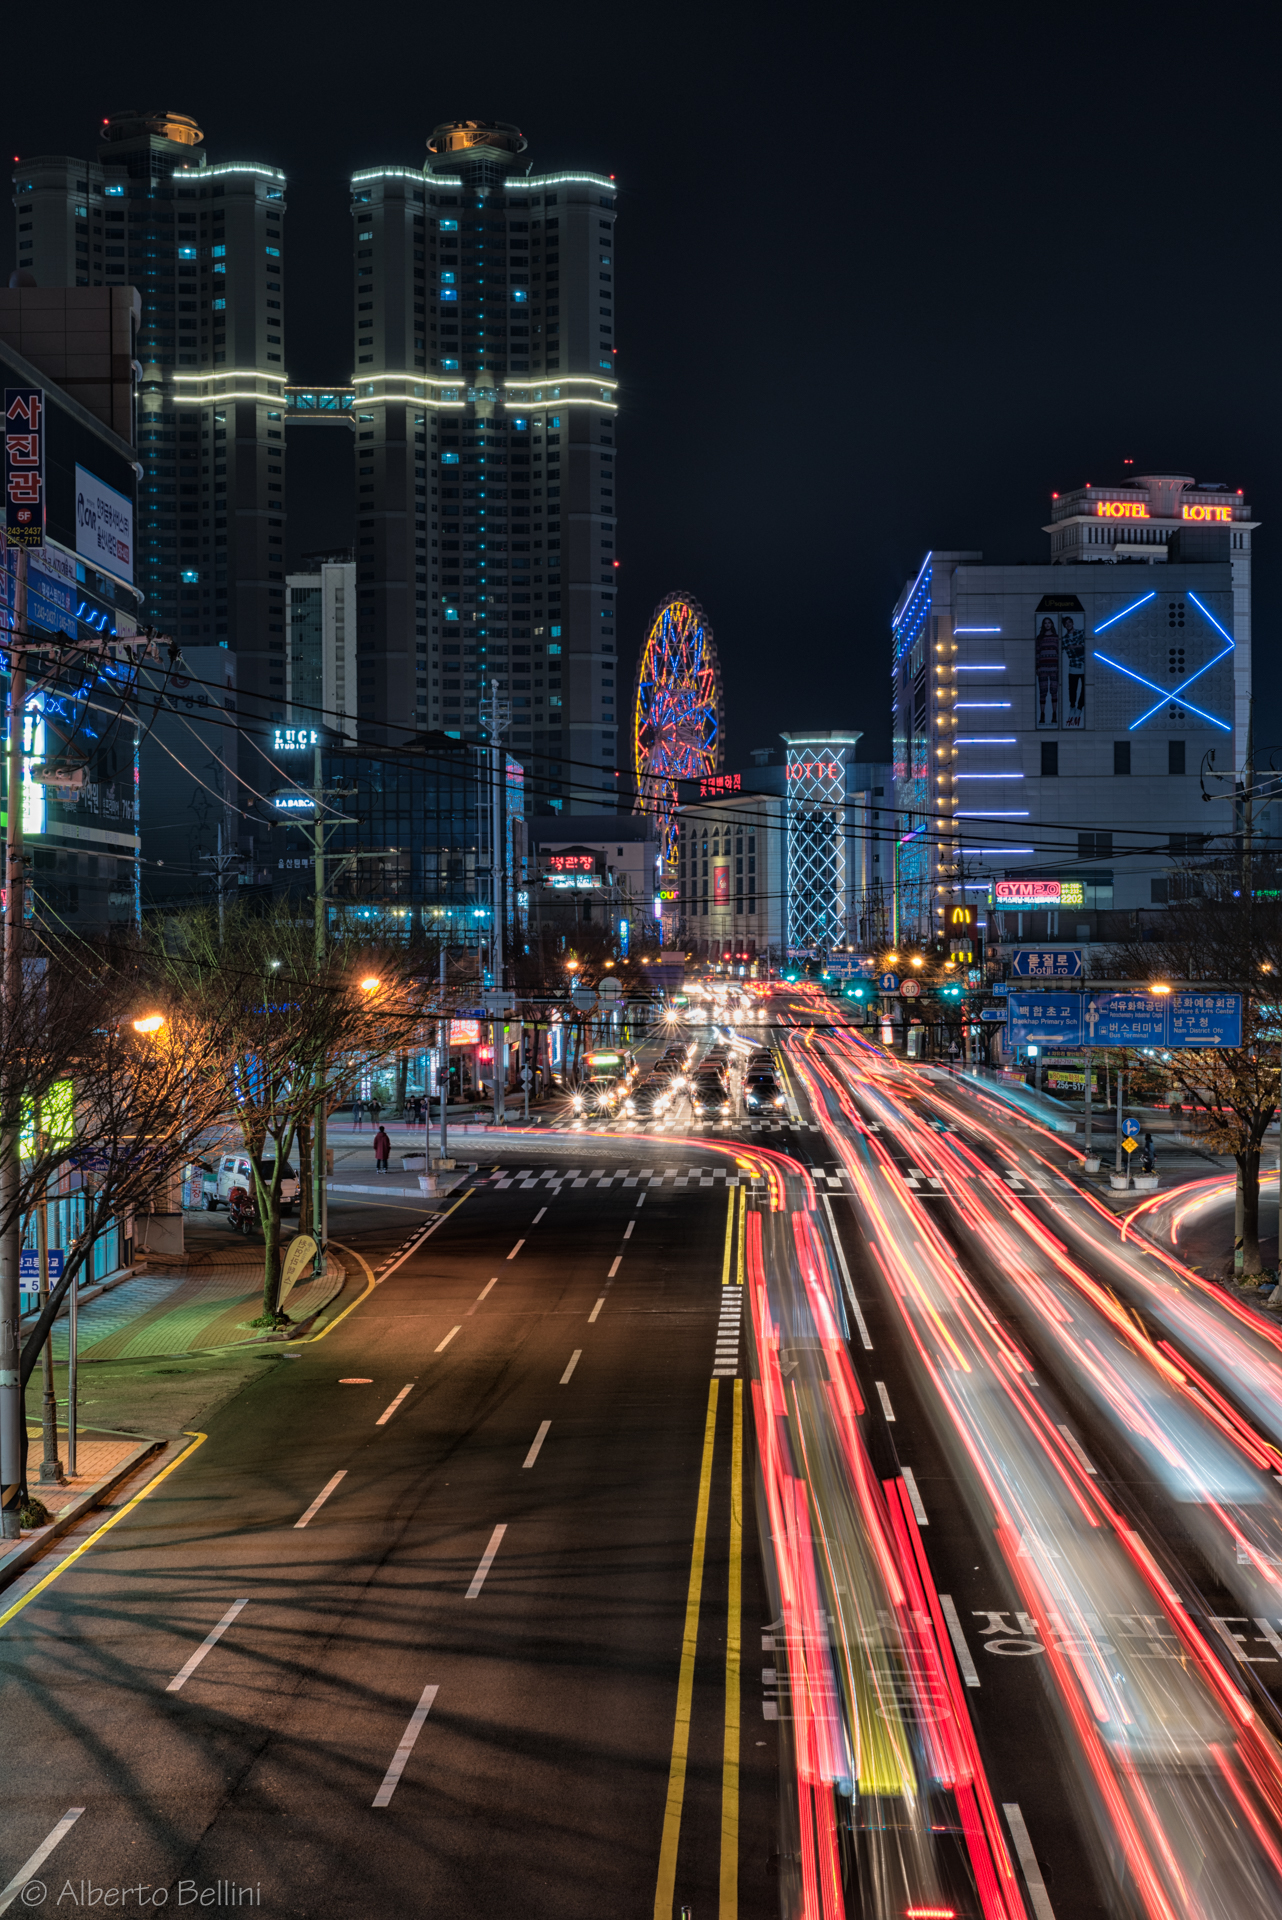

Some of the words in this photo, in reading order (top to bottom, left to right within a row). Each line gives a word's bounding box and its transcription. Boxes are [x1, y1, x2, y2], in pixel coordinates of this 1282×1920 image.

[6, 395, 42, 503] 사진관
[18, 512, 31, 521] 5F
[1097, 502, 1150, 518] HOTEL
[1182, 505, 1232, 521] LOTTE
[7, 527, 42, 535] 243-2437
[786, 763, 837, 779] LOTTE
[700, 773, 741, 797] 롯데백화점
[551, 856, 593, 870] 정관장
[999, 884, 1059, 896] GYM2.0
[1061, 894, 1083, 903] 2202
[1028, 954, 1069, 967] 돋질로
[905, 985, 915, 993] 60
[1109, 1001, 1164, 1012] 석유화학공단
[1172, 998, 1236, 1008] 문화예술회관
[1019, 1006, 1071, 1017] 백합초교
[1109, 1022, 1163, 1033] 버스터미널
[1173, 1017, 1209, 1027] 남구청
